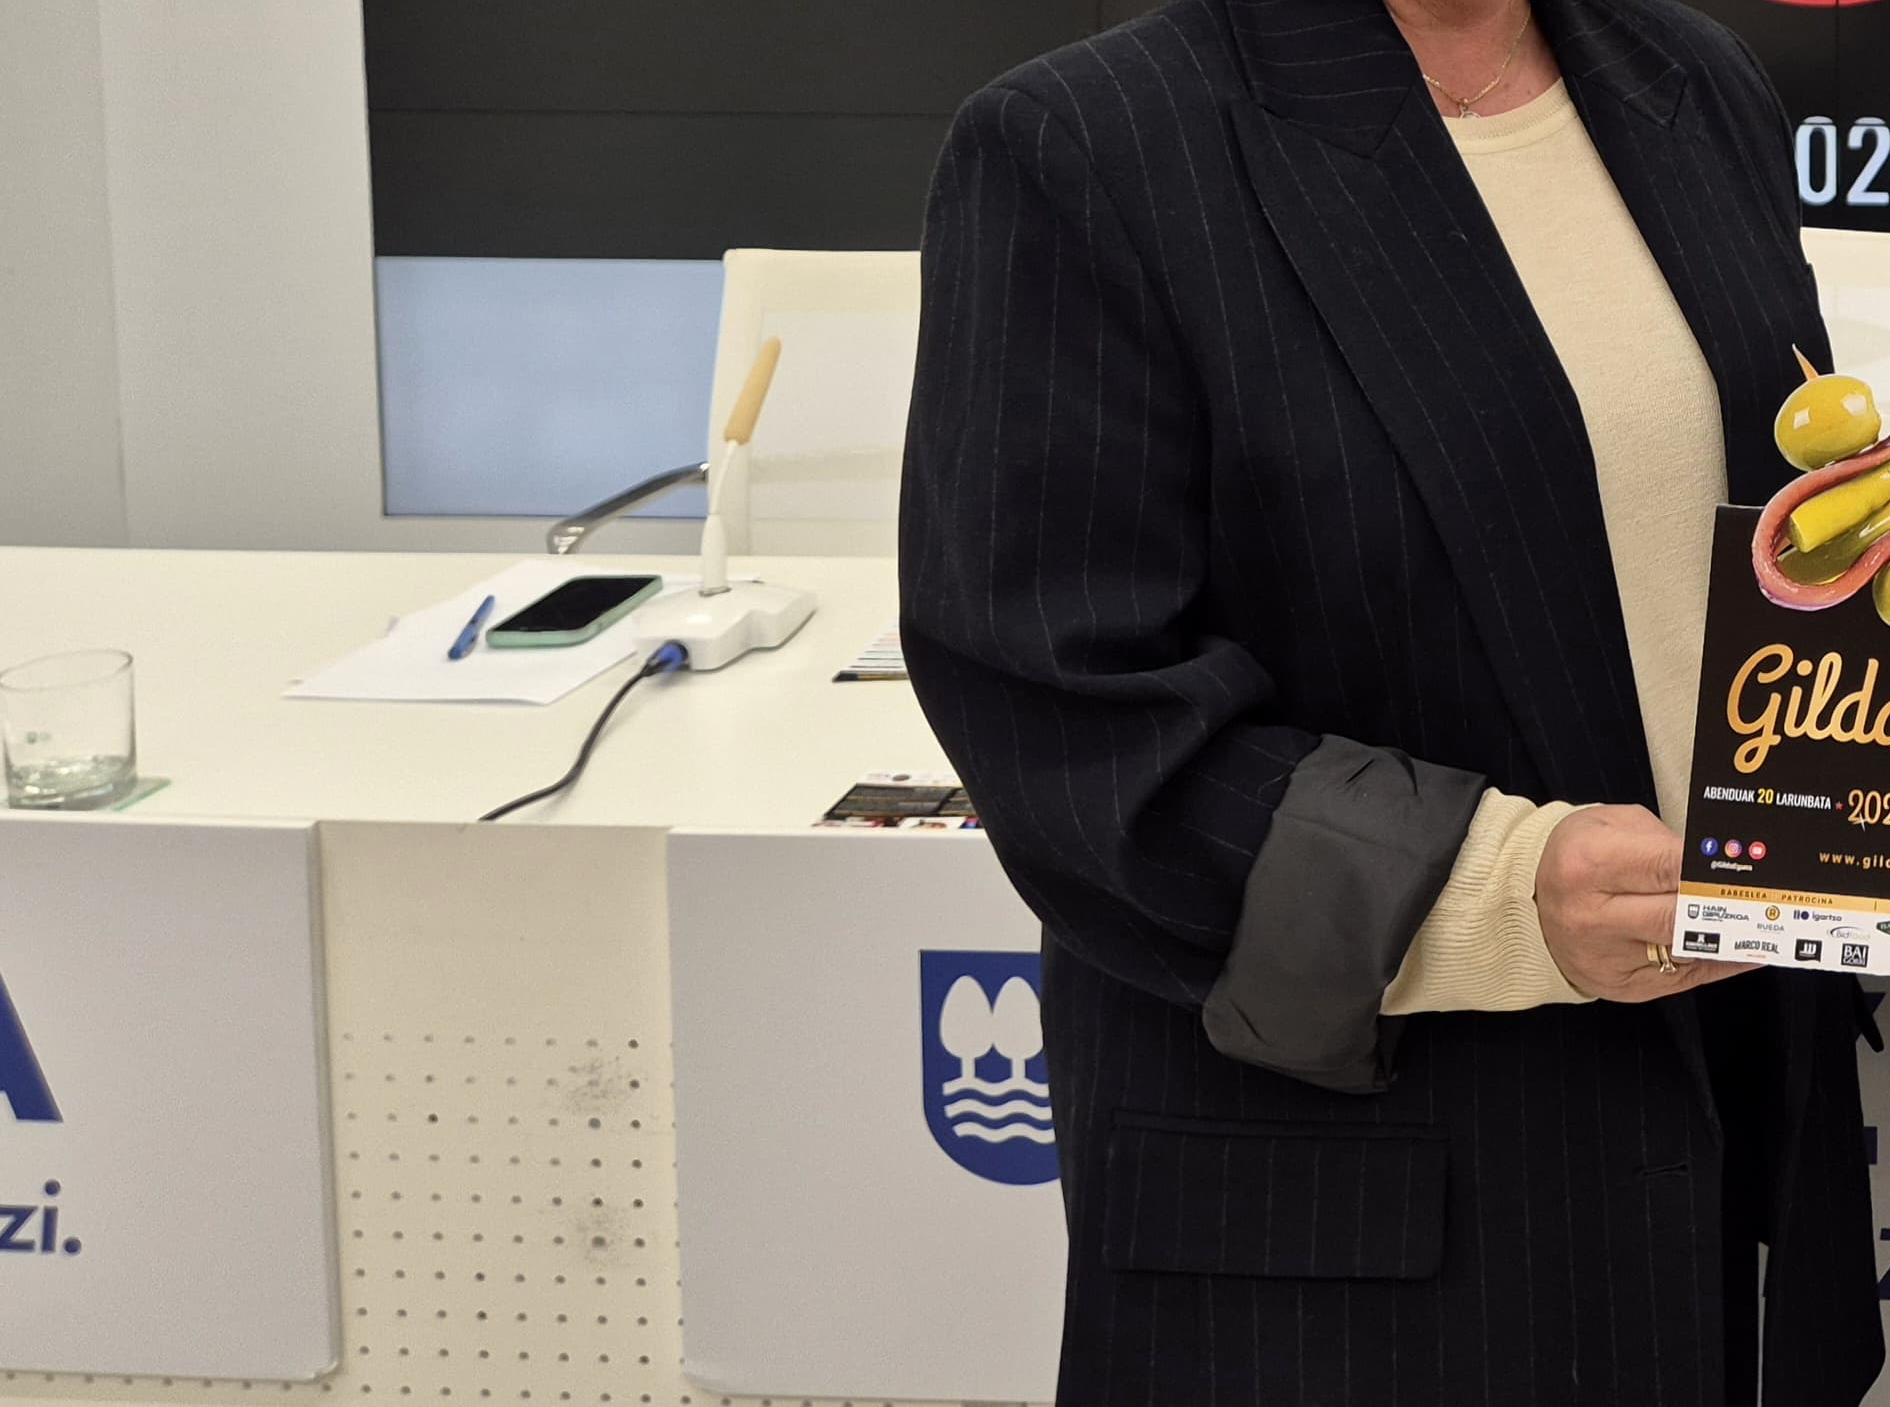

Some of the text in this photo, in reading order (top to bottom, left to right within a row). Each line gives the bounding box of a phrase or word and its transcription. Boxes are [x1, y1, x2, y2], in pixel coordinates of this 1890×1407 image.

[1703, 785, 1755, 803] ABENDUAK
[1757, 788, 1775, 805] 20
[1775, 792, 1832, 810] LARUNBATA
[1781, 894, 1834, 905] PATROCINA
